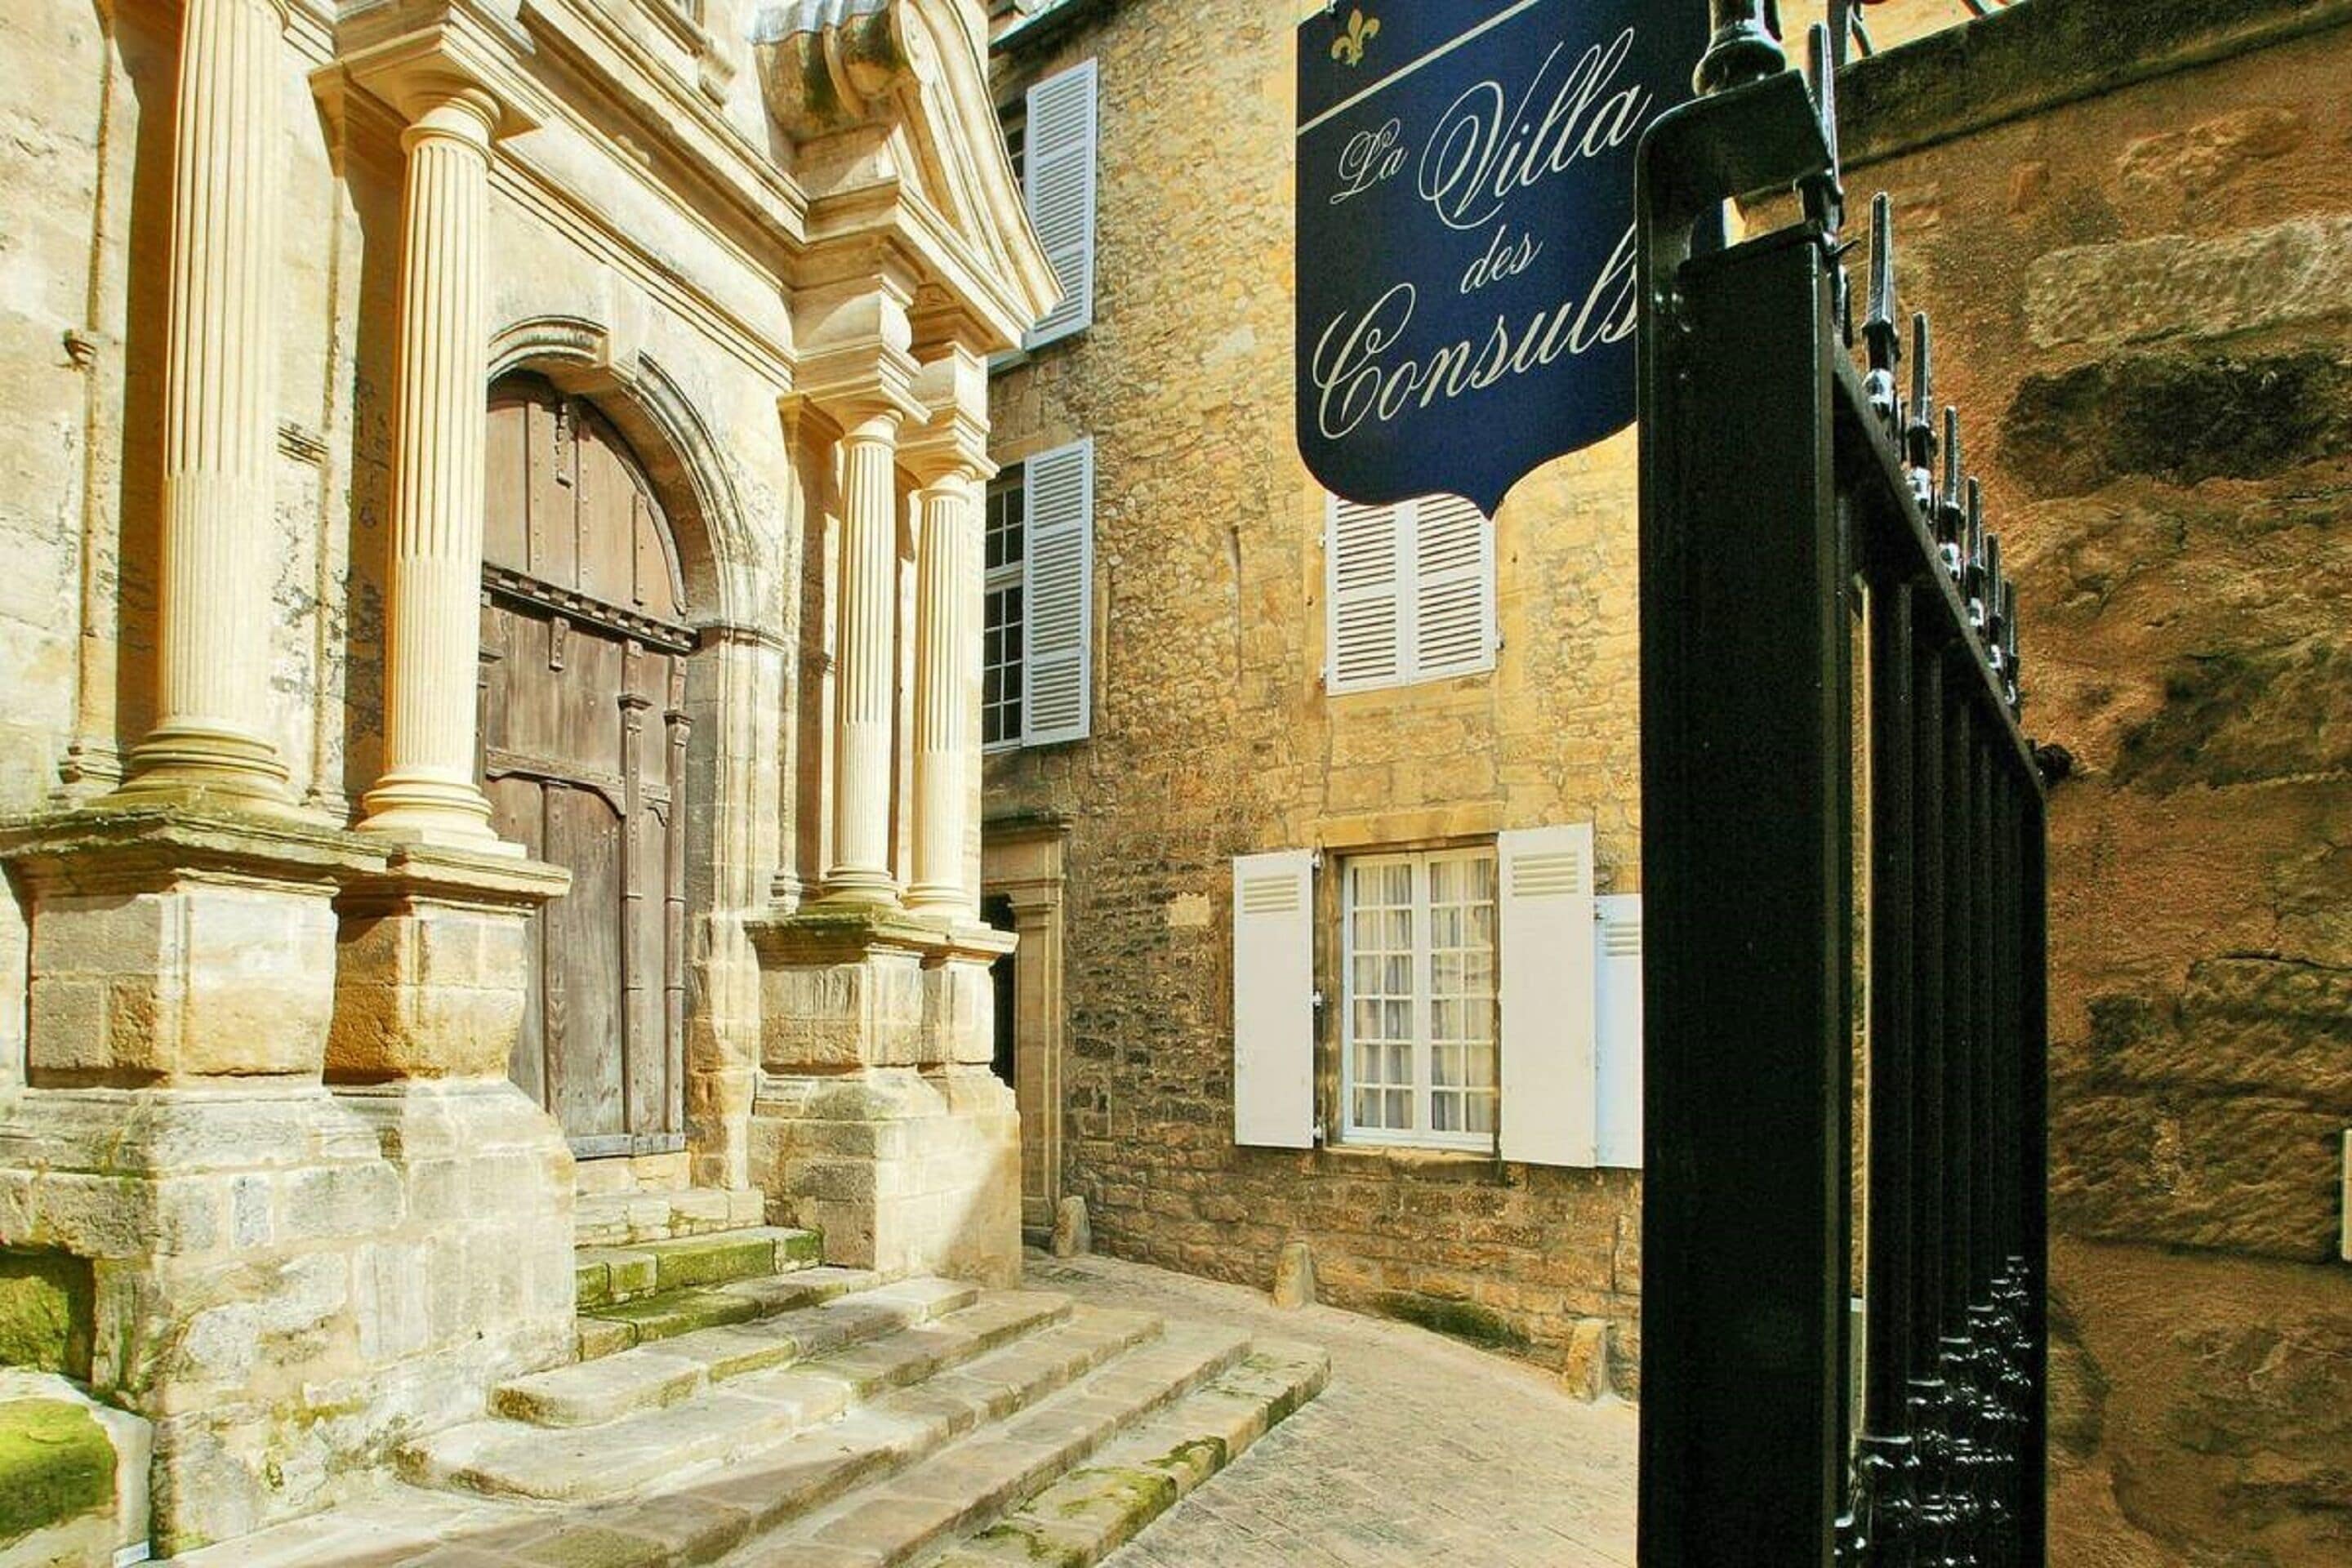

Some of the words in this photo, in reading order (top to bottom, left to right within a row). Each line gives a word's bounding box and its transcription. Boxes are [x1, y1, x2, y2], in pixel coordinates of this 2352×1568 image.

[1330, 118, 1410, 203] La
[1419, 27, 1652, 229] Villa
[1312, 222, 1637, 439] Consuls
[1460, 225, 1543, 294] des
